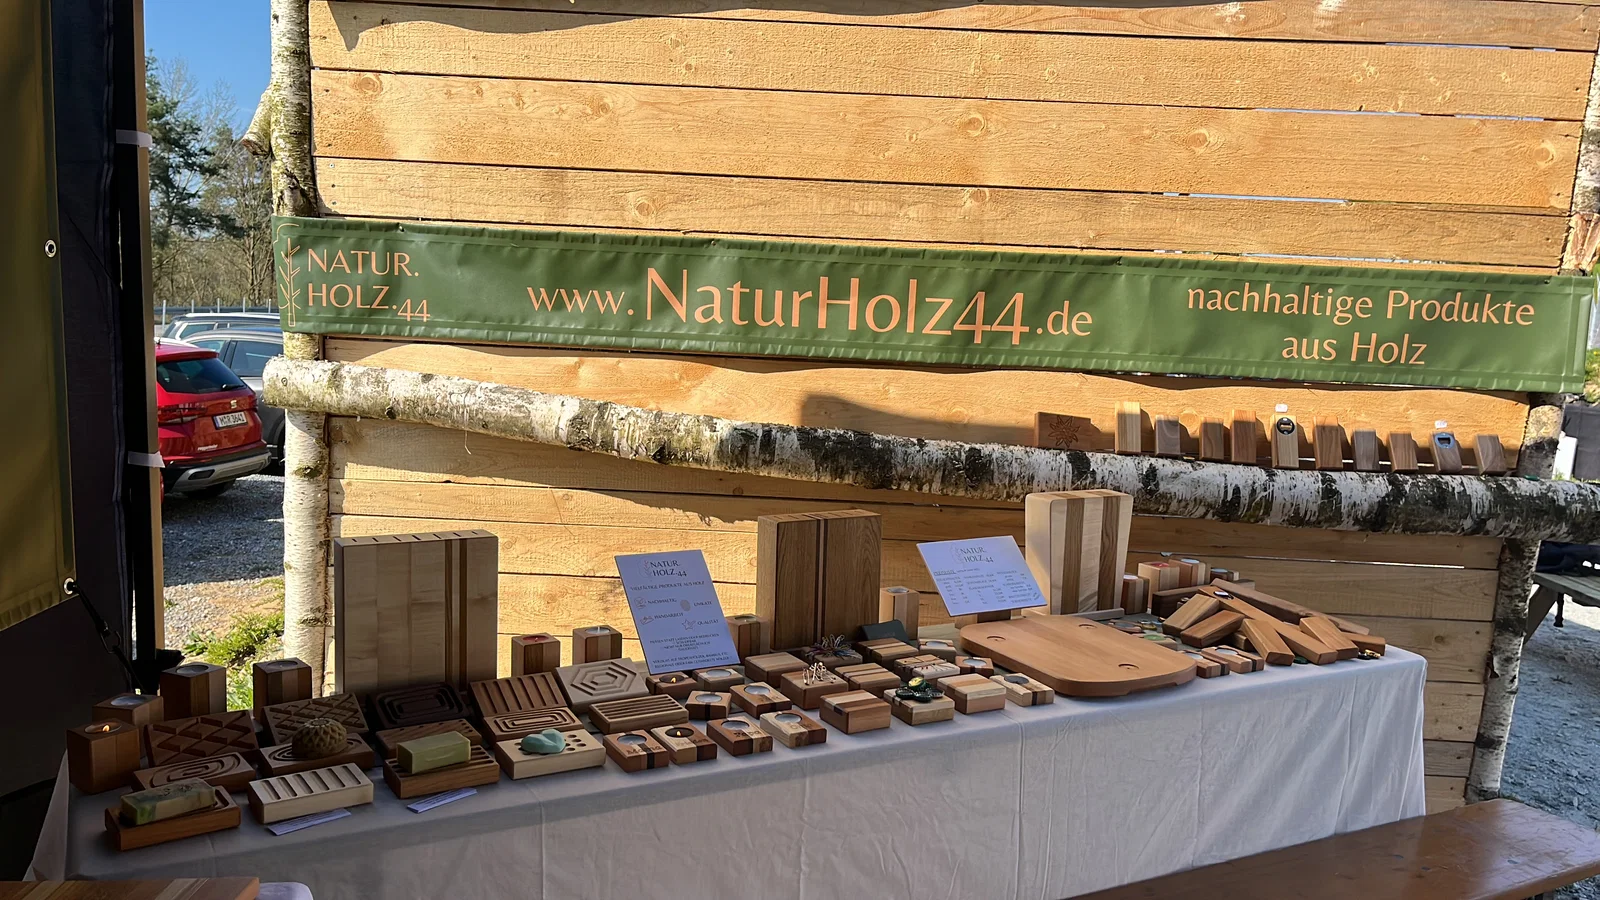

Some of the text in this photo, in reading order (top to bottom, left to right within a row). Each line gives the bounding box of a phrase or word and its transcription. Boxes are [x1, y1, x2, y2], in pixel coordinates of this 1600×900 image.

[308, 249, 419, 277] NATUR.
[526, 267, 1093, 345] www.NaturHolz44.de
[1187, 282, 1535, 326] nachhaltige Produkte
[1281, 331, 1428, 365] aus Holz
